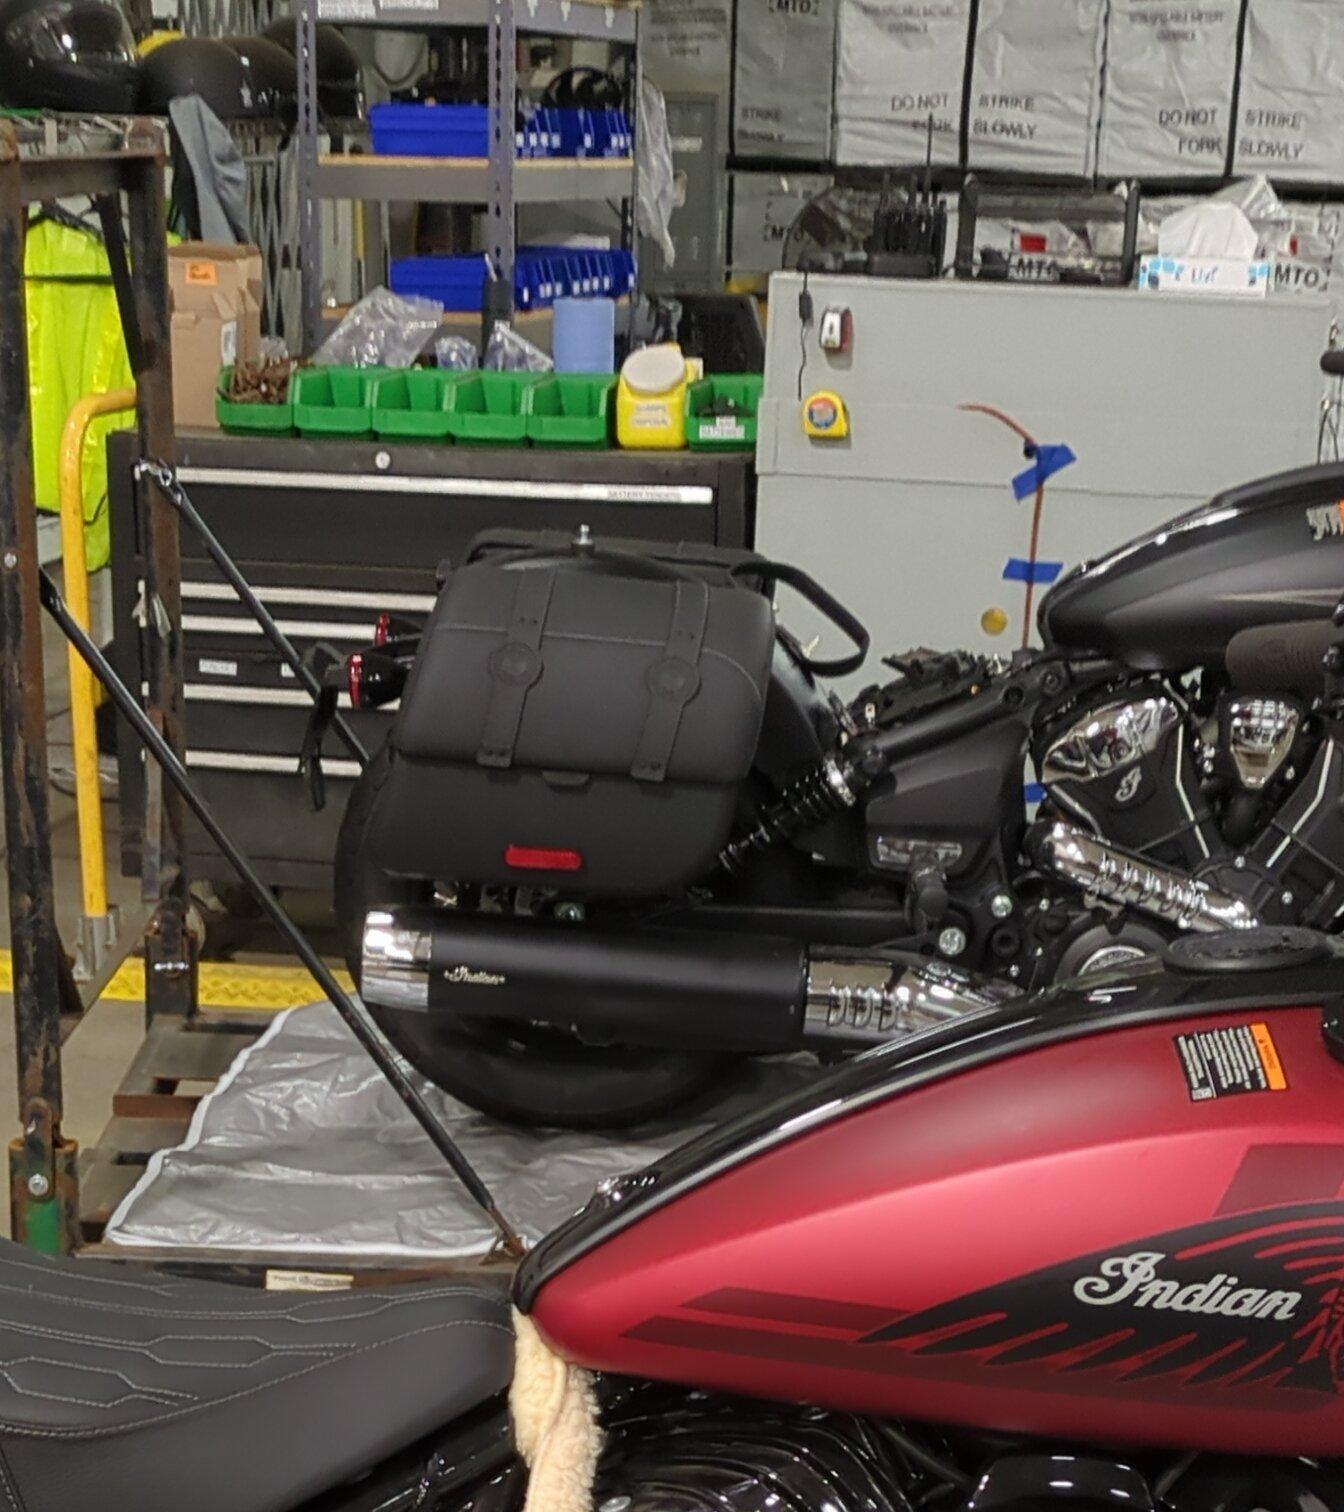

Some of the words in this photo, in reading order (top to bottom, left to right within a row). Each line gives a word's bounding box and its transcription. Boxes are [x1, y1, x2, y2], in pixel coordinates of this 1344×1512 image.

[890, 96, 915, 111] DO
[917, 93, 948, 109] NOT
[979, 95, 1034, 111] STRIKE
[1158, 109, 1188, 126] DO
[1190, 108, 1218, 126] NOT
[1244, 109, 1302, 131] STRIKE
[972, 120, 1037, 139] SLOWLY
[1177, 136, 1223, 156] FORK
[1238, 138, 1304, 160] SLOWLY
[1274, 262, 1320, 289] MTO
[1072, 1251, 1303, 1321] Indian
